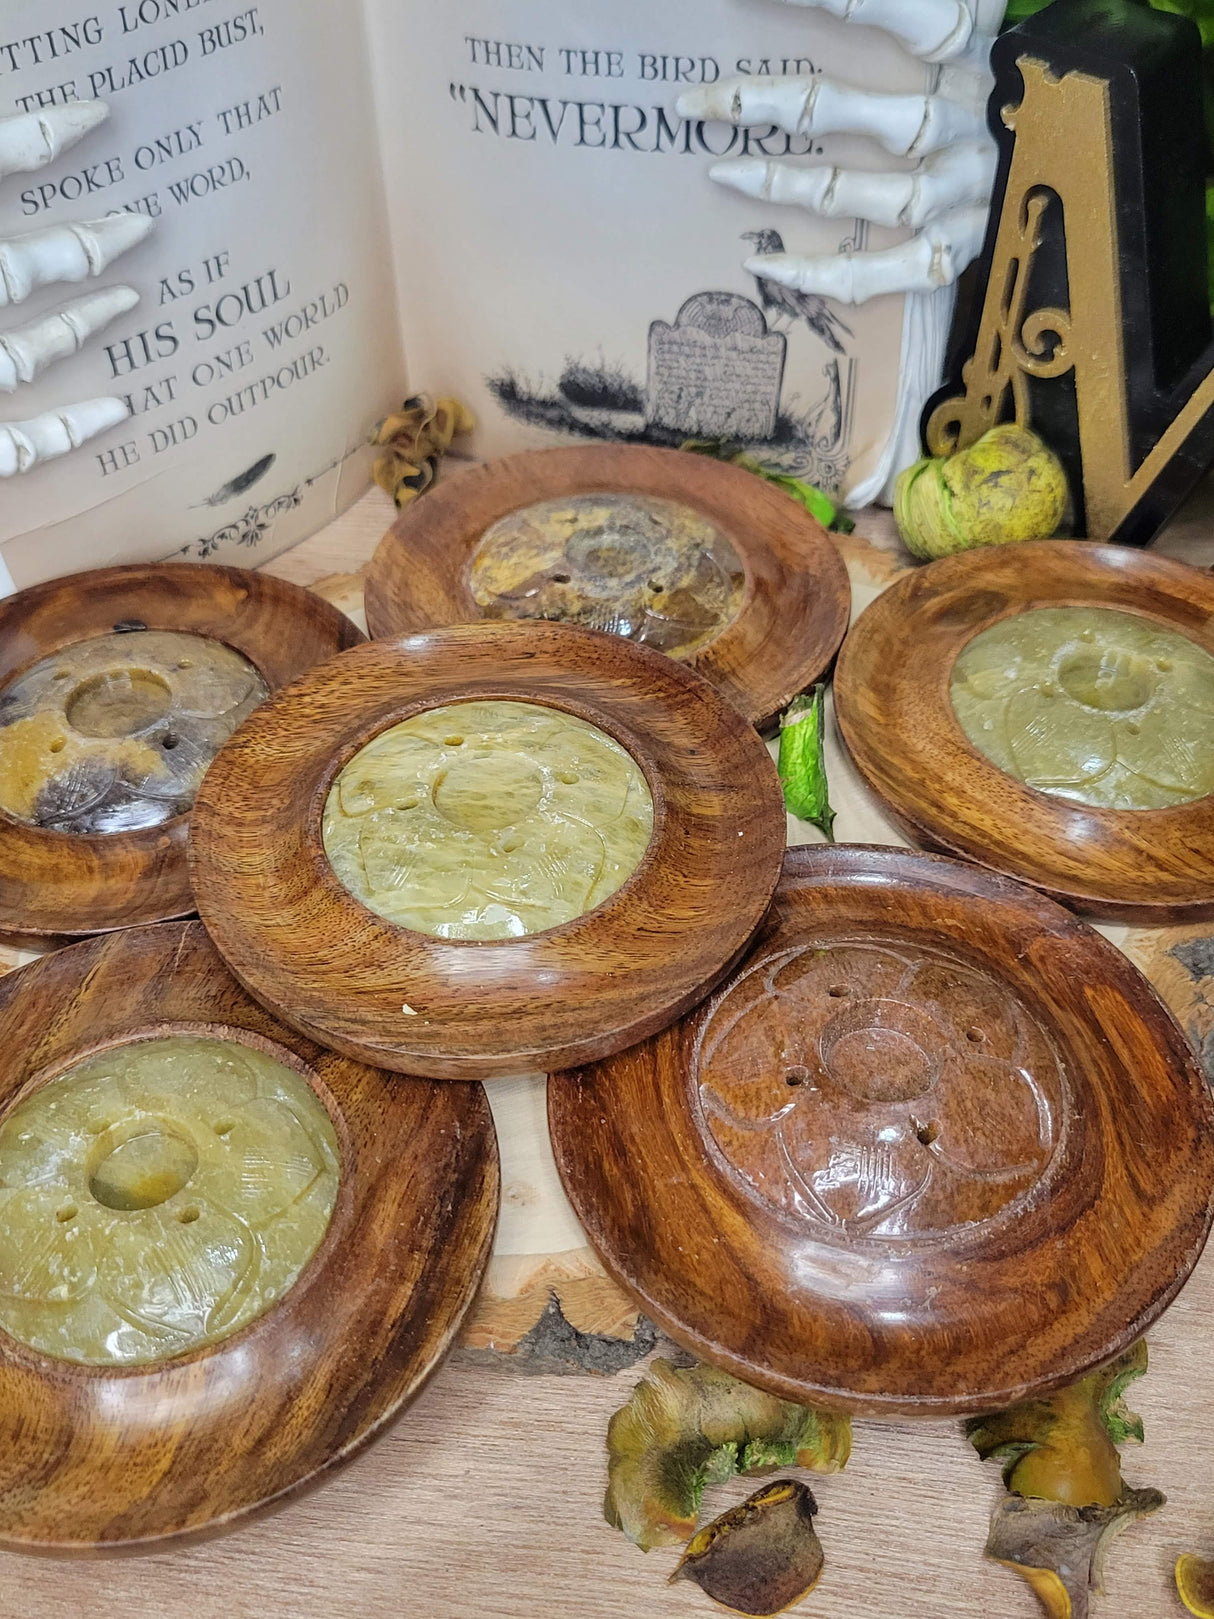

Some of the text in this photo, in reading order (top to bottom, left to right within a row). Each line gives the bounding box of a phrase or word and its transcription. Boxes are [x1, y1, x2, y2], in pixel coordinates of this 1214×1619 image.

[0, 0, 213, 75] TTING LON
[15, 9, 264, 113] THE PLACID BUST,
[465, 35, 545, 72] THEN
[559, 48, 624, 78] THE
[637, 53, 720, 84] BIRD
[20, 86, 283, 216] SPOKE ONLY THAT
[168, 156, 251, 206] WORD,
[103, 268, 291, 379] HIS SOUL
[158, 251, 231, 306] AS IF
[191, 340, 254, 387] ONE
[261, 283, 349, 350] WORLD
[95, 345, 331, 478] HE DID OUTPOUR.
